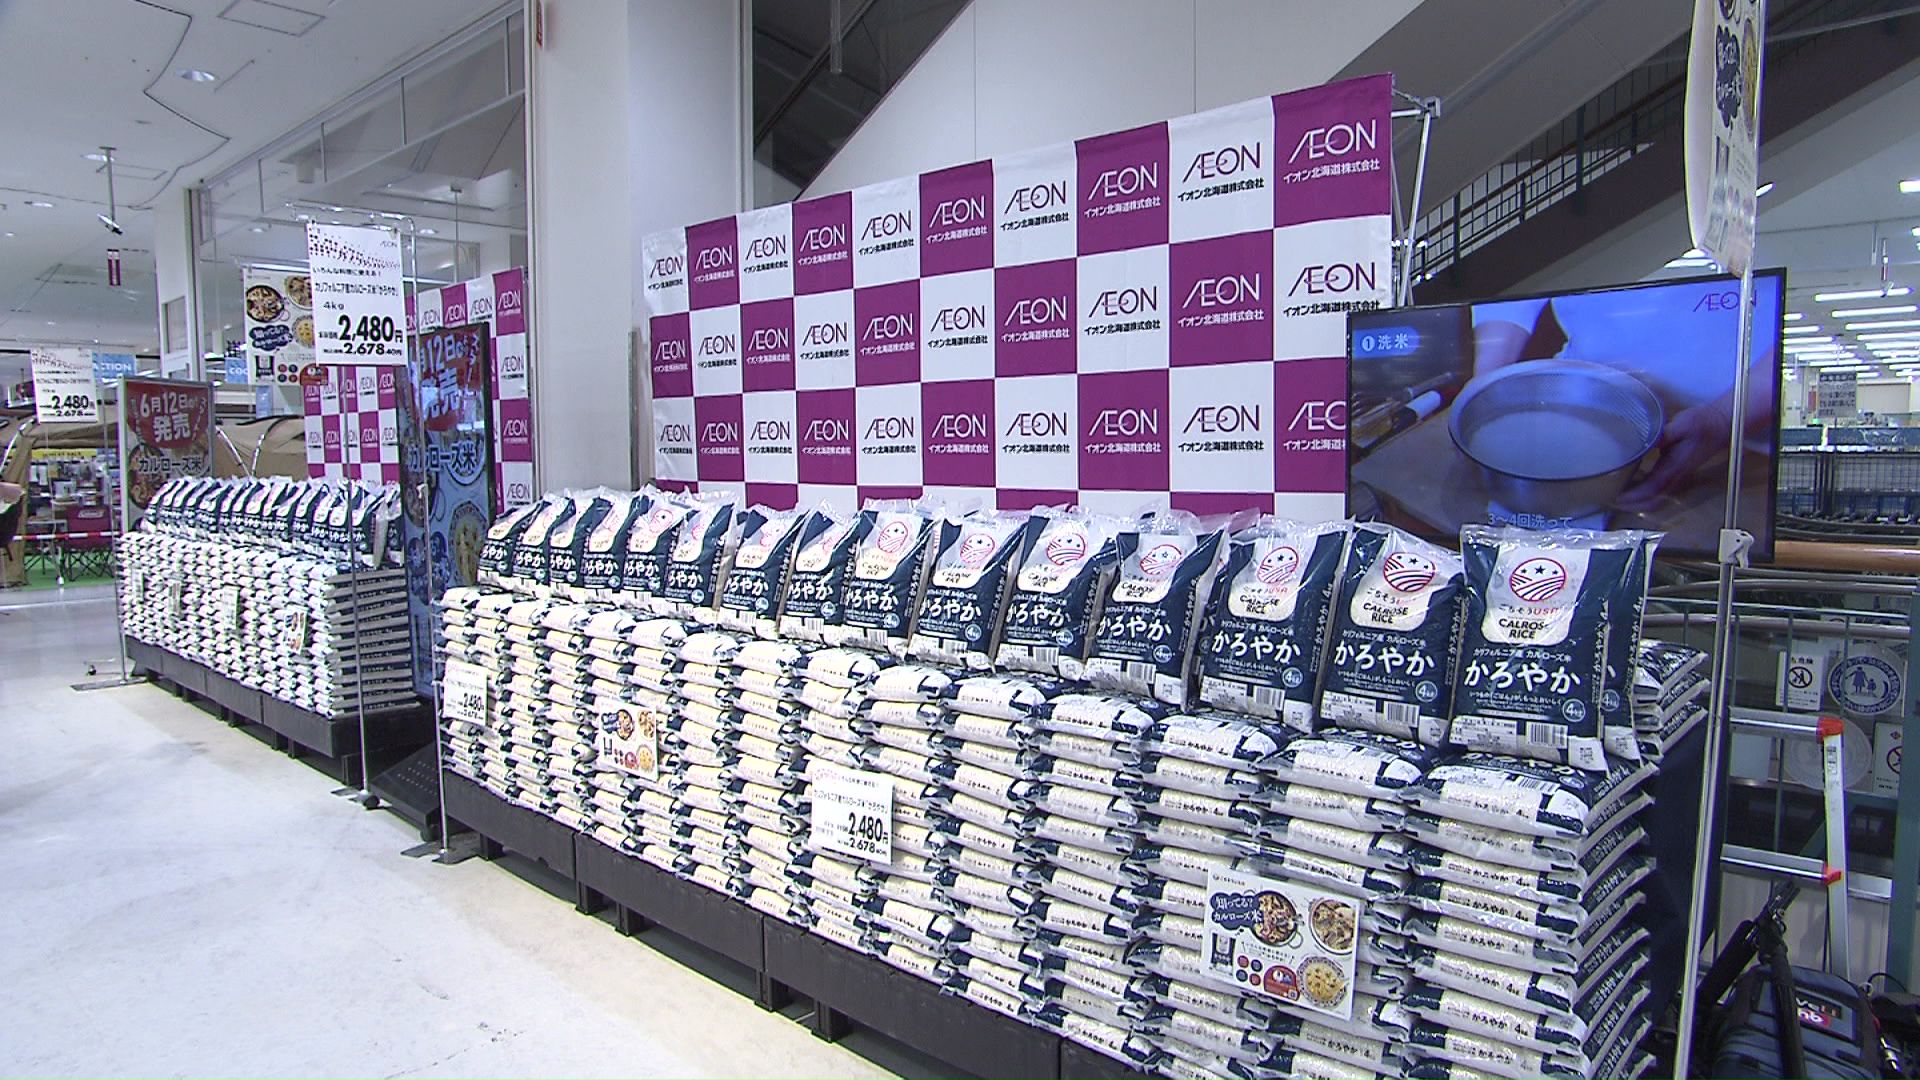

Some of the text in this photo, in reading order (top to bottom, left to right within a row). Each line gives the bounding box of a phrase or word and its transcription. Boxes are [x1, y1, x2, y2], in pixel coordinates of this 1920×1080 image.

[1283, 158, 1380, 184] イオン北海道株式会社
[1178, 177, 1264, 202] イオン北海道株式会社
[1084, 197, 1161, 219] イオン北海道株式会社
[1001, 212, 1069, 231] イオン北海道株式会社
[926, 225, 987, 244] イオン北海道株式会社
[1283, 300, 1380, 317] イオン北海道株式会社
[1084, 319, 1161, 336] イオン北海道株式会社
[1178, 309, 1264, 328] イオン北海道株式会社
[928, 335, 988, 348] イオン北海道株式会社
[1001, 328, 1070, 343] イオン北海道株式会社
[1288, 400, 1346, 432] ÆO
[153, 412, 191, 443] 発売
[928, 443, 989, 454] イオン北海道株式会社
[1002, 443, 1070, 454] イオン北海道株式会社
[1085, 442, 1161, 455] イオン北海道株式会社
[1178, 440, 1264, 453] イオン北海道株式会社
[1096, 615, 1172, 641] かろやか
[1508, 629, 1537, 640] RICE
[1212, 629, 1300, 663] かろやか
[1334, 639, 1435, 676] かろやか
[1464, 659, 1581, 694] かろやか
